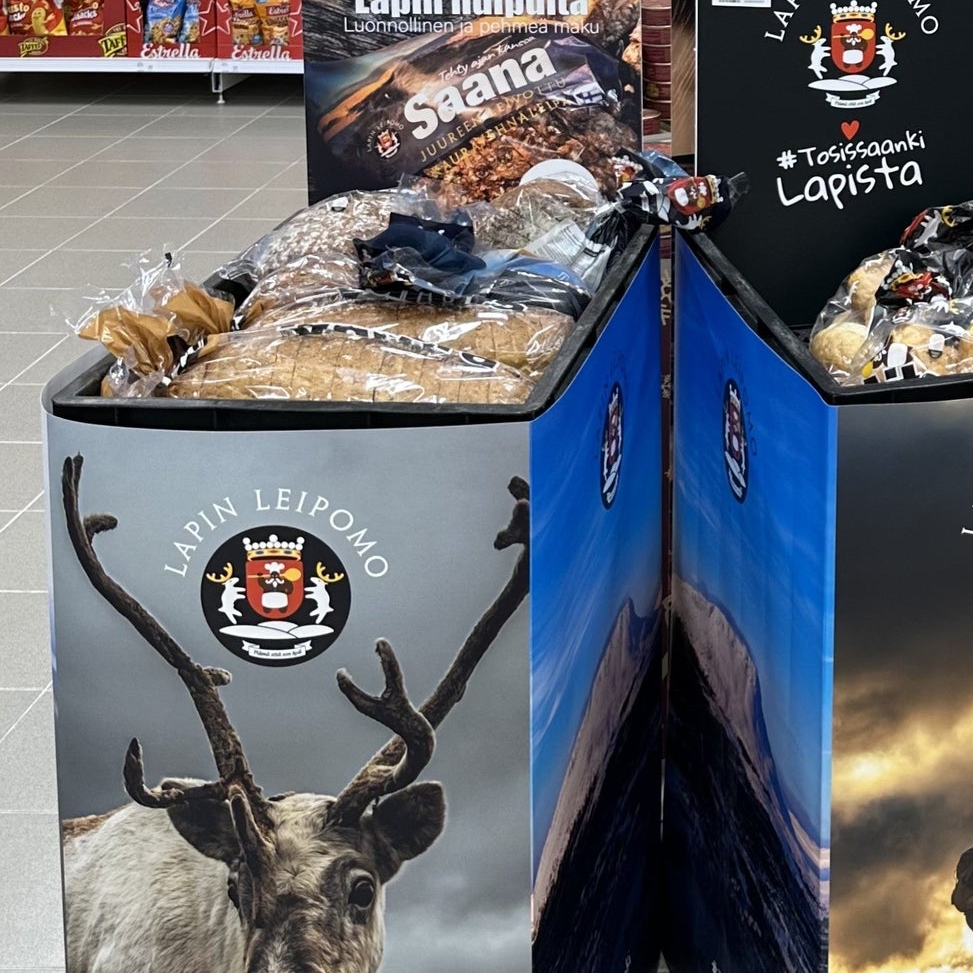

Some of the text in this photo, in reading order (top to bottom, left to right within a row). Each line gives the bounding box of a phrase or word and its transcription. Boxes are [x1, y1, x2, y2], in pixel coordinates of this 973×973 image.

[343, 16, 600, 36] Luonnollinen ja pehmeä maku
[140, 42, 200, 59] Estrella
[231, 44, 291, 60] Estrella
[776, 129, 926, 170] #Tosissaanki
[775, 156, 924, 211] Lapista
[162, 487, 389, 580] LAPIN LEIPOMO
